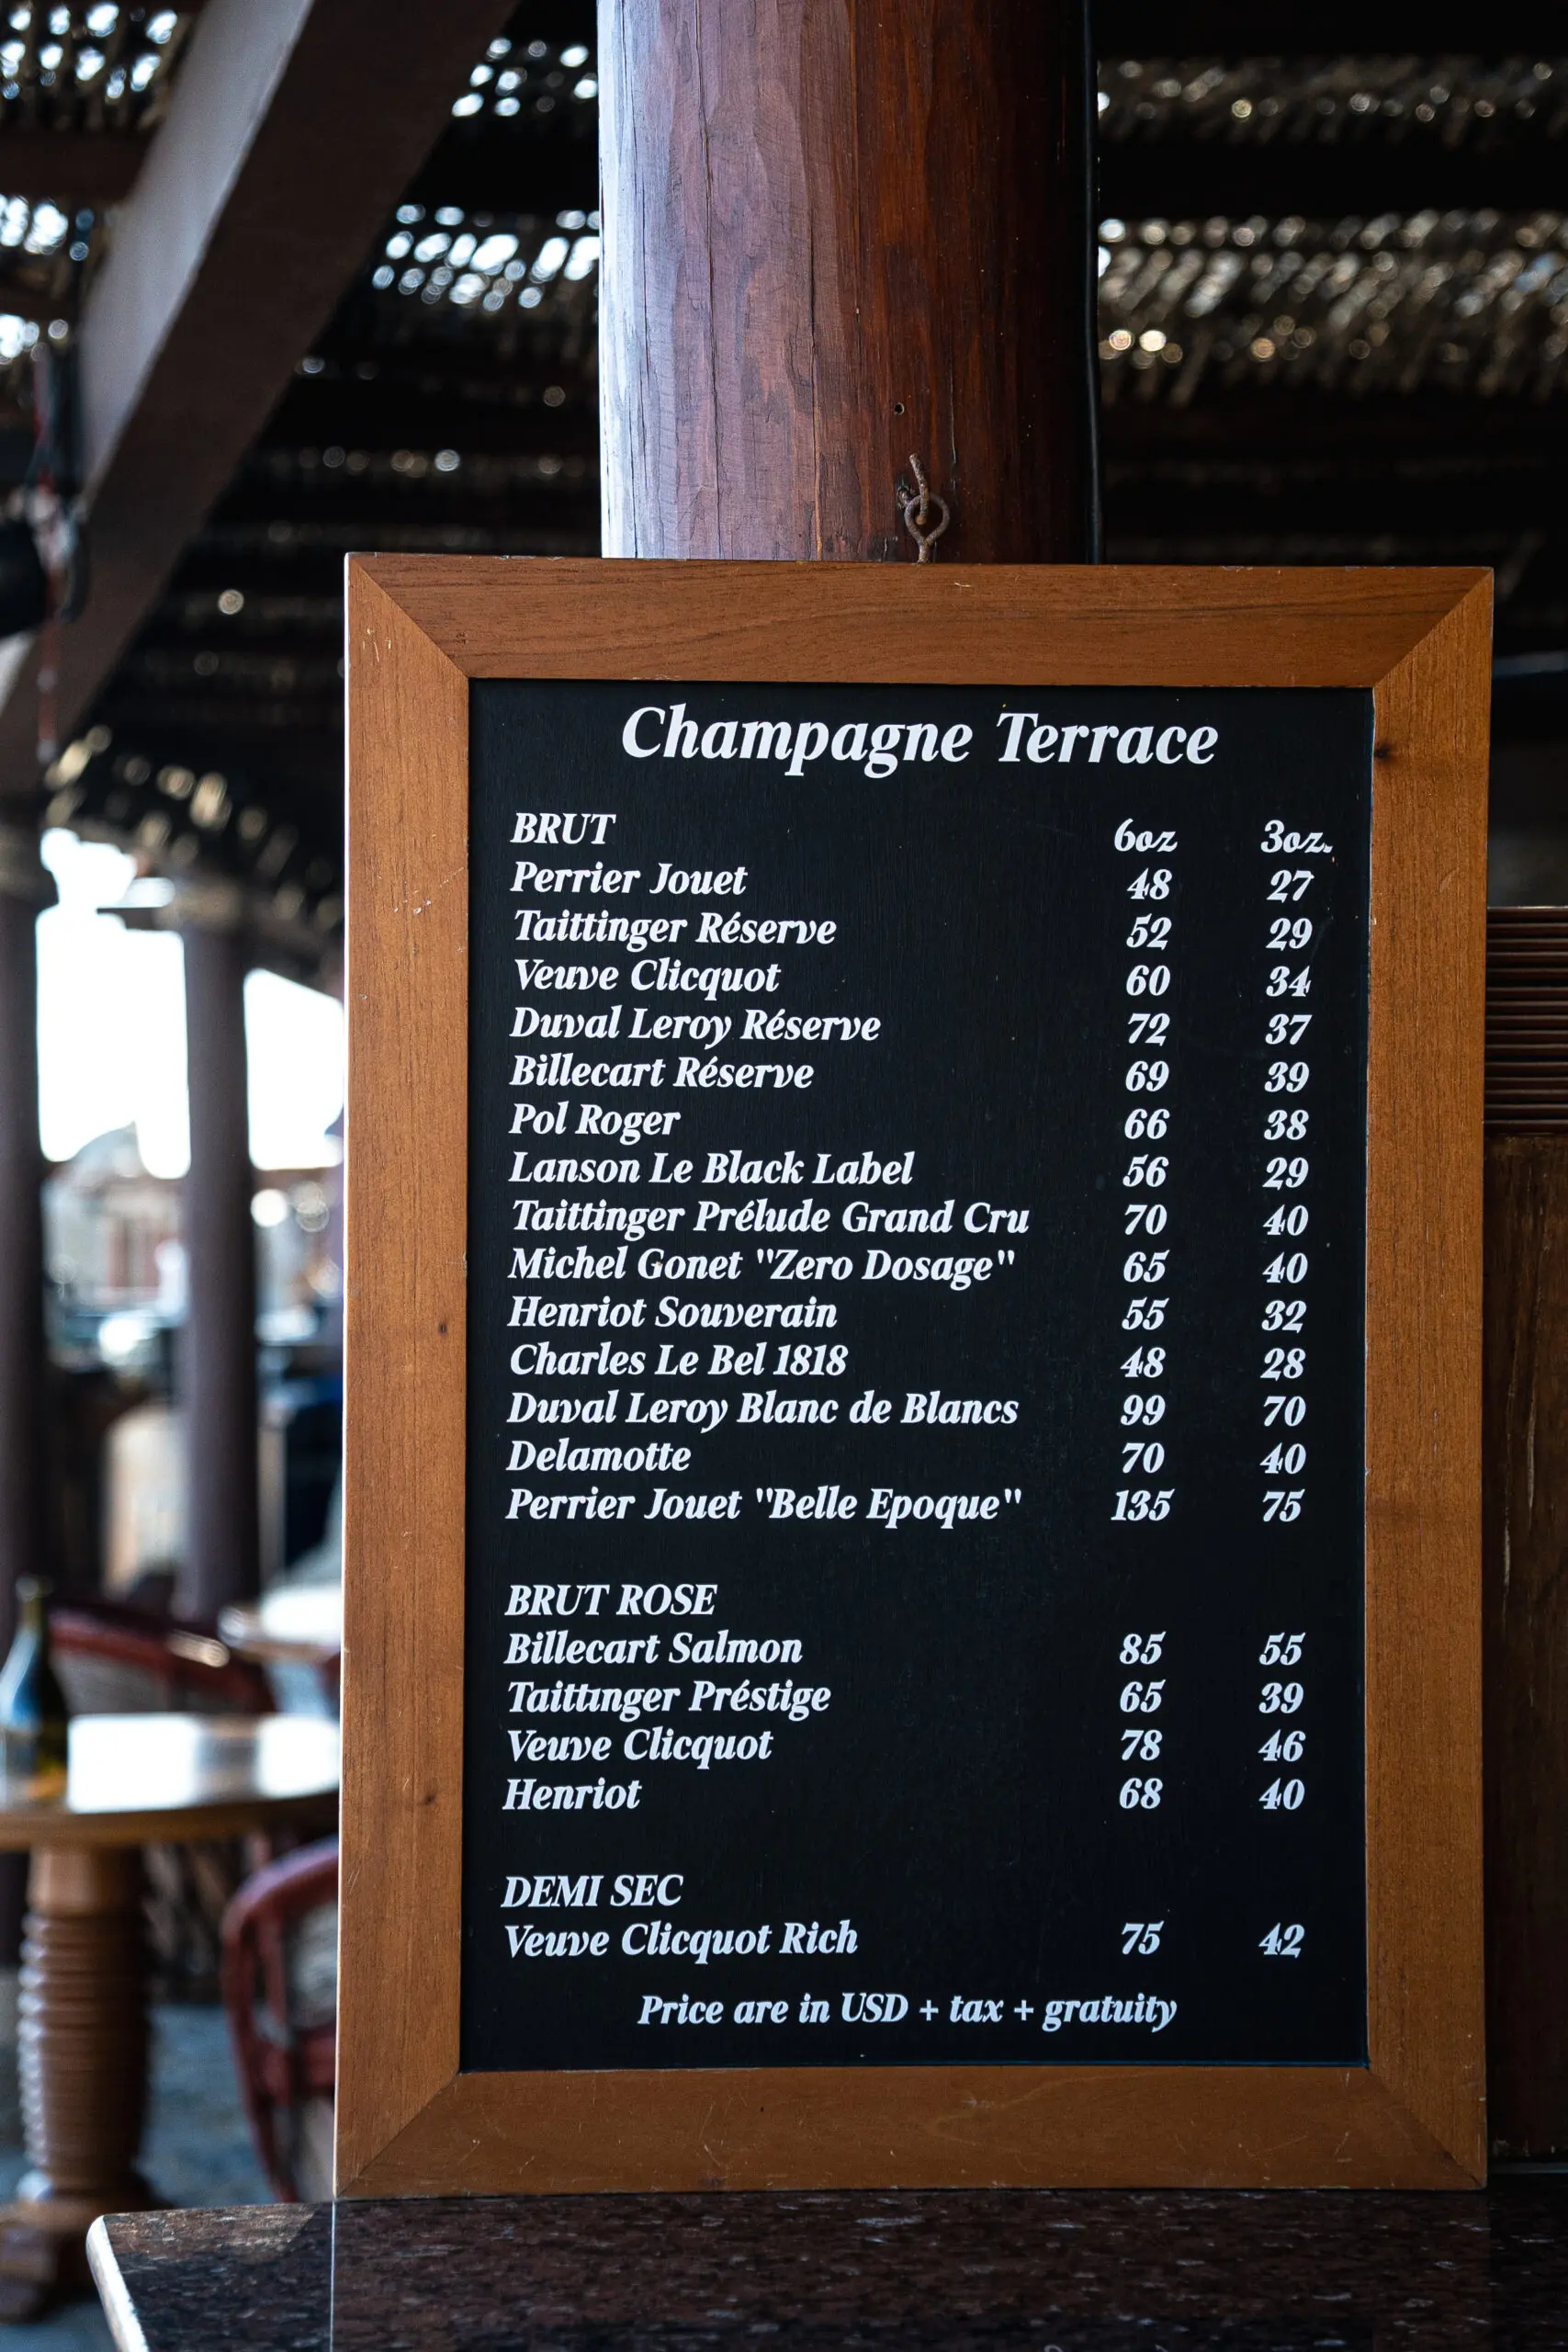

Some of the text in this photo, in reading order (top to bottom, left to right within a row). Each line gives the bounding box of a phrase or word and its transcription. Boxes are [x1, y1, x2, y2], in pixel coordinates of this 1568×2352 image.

[622, 702, 1219, 779] Champagne Terrace
[509, 812, 1333, 854] BRUT 6oz 3oz.
[509, 861, 1315, 904] Perrier Jouet 48 27
[513, 909, 1314, 953] Taittinger Réserve 52 29
[513, 956, 1312, 1001] Veuve Clicquot 60 34
[508, 1004, 1313, 1050] Duval Leroy Réserve 72 37
[508, 1052, 1310, 1093] Billecart Réserve 69 39
[507, 1100, 1310, 1146] Pol Roger 66 38
[507, 1149, 1309, 1191] Lanson Le Black Label 56 29
[512, 1197, 1309, 1242] Taittinger Prélude Grand Cru 70 40
[506, 1245, 1308, 1292] Michel Gonet "Zero Dosage" 65 40
[506, 1295, 1307, 1334] Henriot Souverain 55 32
[510, 1340, 1306, 1382] Charles Le Bel 1818 48 28
[506, 1389, 1306, 1434] Duval Leroy Blanc de Blancs 99 70
[505, 1437, 1307, 1475] Delamotte 70 40
[504, 1485, 1305, 1530] Perrier Jouet "Belle Epoque" 135 75
[503, 1583, 718, 1616] BRUT ROSE
[502, 1629, 1306, 1666] Billecart Salmon 85 55
[687, 1679, 831, 1722] Préstige
[1120, 1679, 1167, 1713] 65
[1258, 1682, 1304, 1714] 39
[507, 1725, 1306, 1770] Veuve Clicquot 78 46
[502, 1777, 1305, 1810] Henriot 68 40
[500, 1873, 684, 1908] DEMI SEC
[504, 1918, 1305, 1965] Veuve Clicquot Rich 75 42
[637, 1992, 1178, 2033] Price are in USD + tax + gratuity
